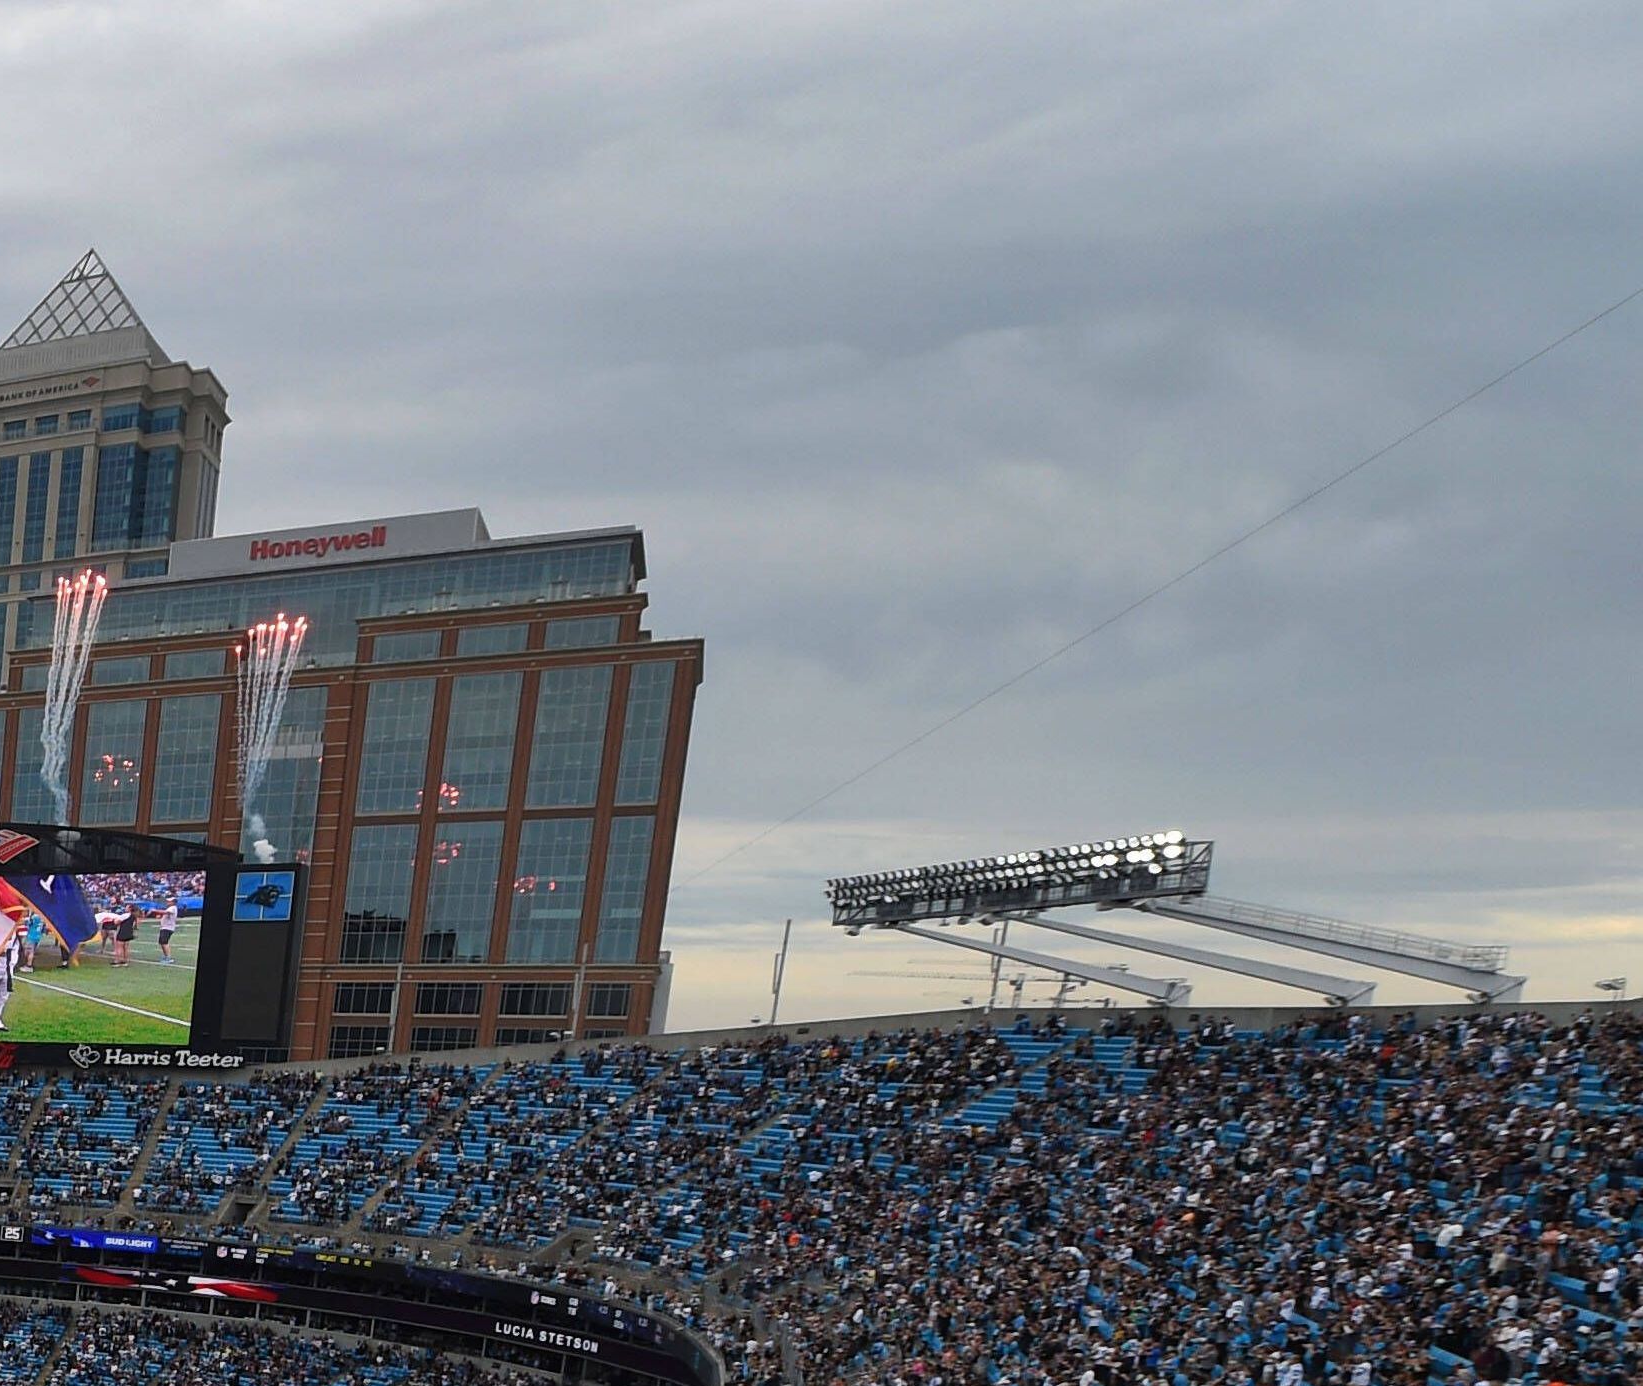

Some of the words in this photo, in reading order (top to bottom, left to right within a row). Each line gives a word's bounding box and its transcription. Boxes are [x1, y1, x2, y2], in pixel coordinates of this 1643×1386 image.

[0, 393, 23, 402] BANK
[26, 390, 37, 398] OF
[39, 383, 78, 396] AMERICA
[249, 525, 387, 561] Honeywell
[104, 1049, 171, 1066] Harris
[175, 1049, 244, 1068] Teeter
[4, 1227, 21, 1240] 25
[104, 1236, 125, 1248] BUD
[126, 1238, 154, 1251] LIGHT
[495, 1321, 535, 1340] LUCIA
[538, 1330, 599, 1354] STETSON
